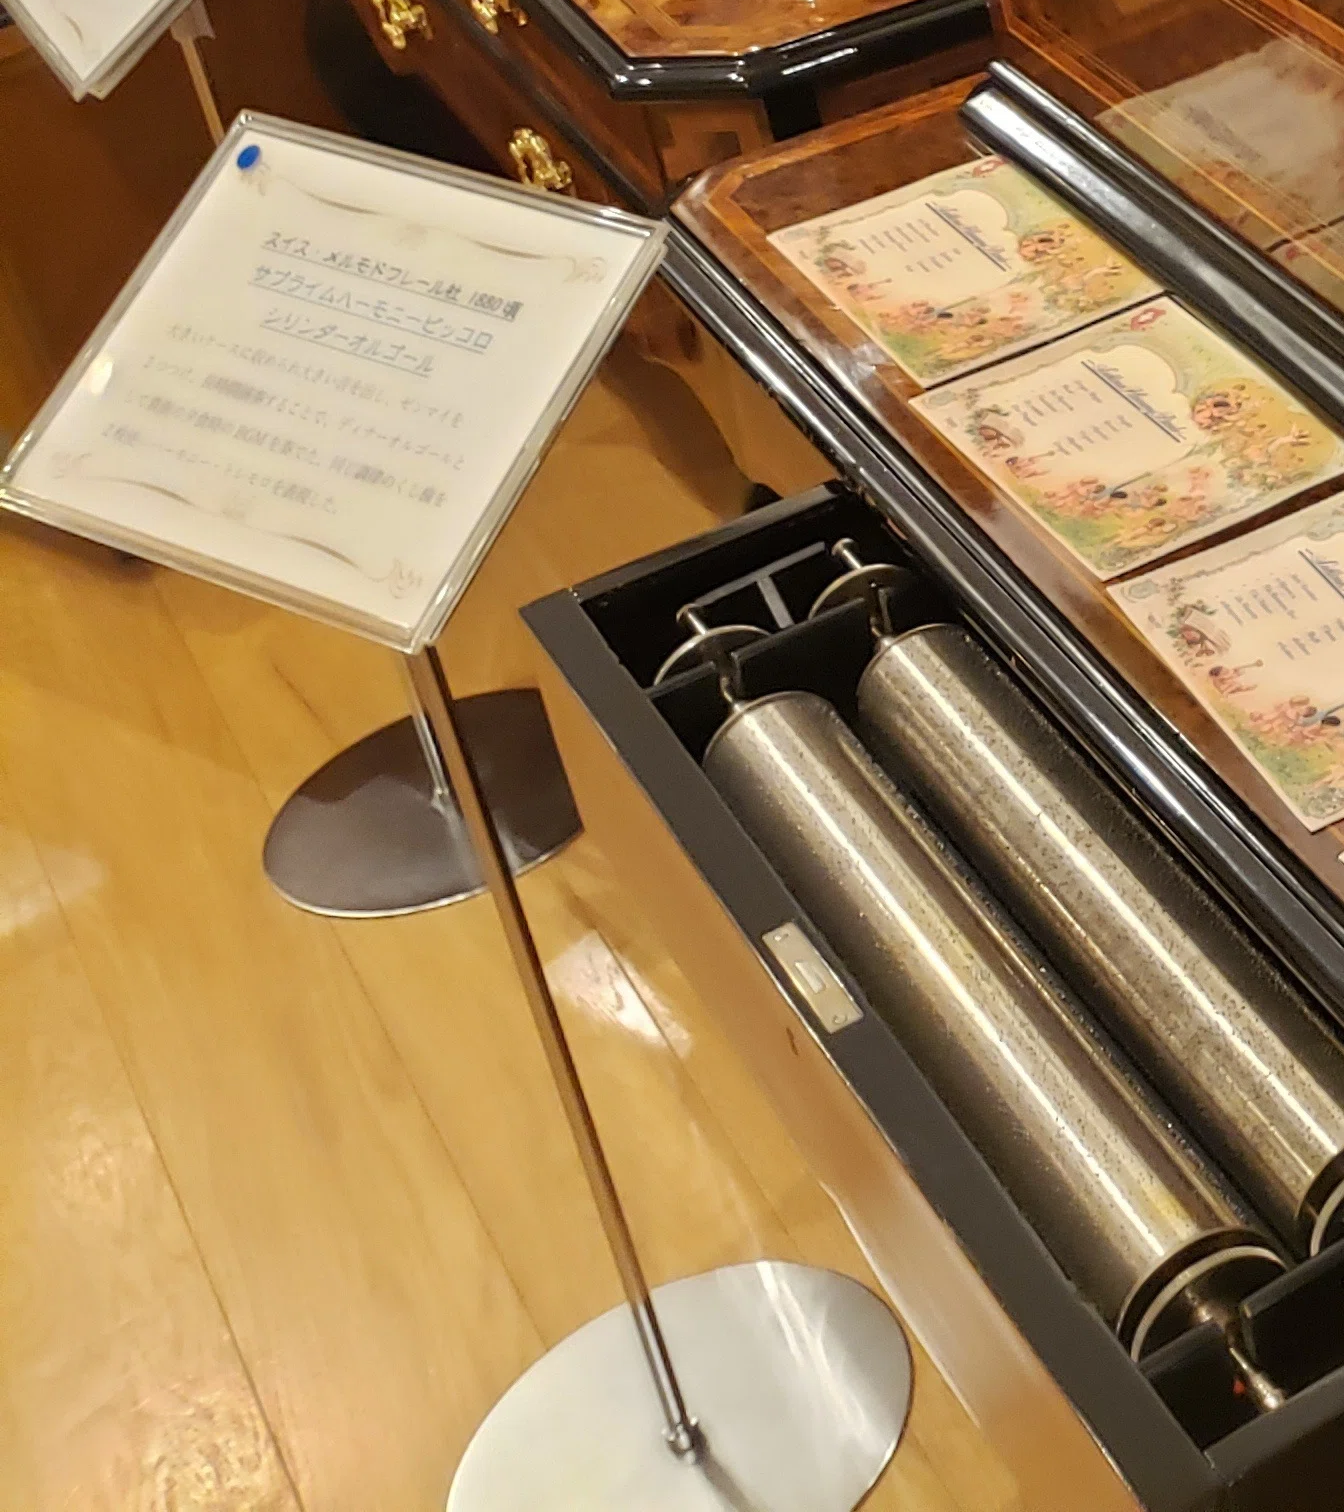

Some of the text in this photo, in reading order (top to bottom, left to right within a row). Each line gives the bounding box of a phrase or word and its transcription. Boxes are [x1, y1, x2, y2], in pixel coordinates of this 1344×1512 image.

[264, 308, 435, 373] シリンダーオルゴール
